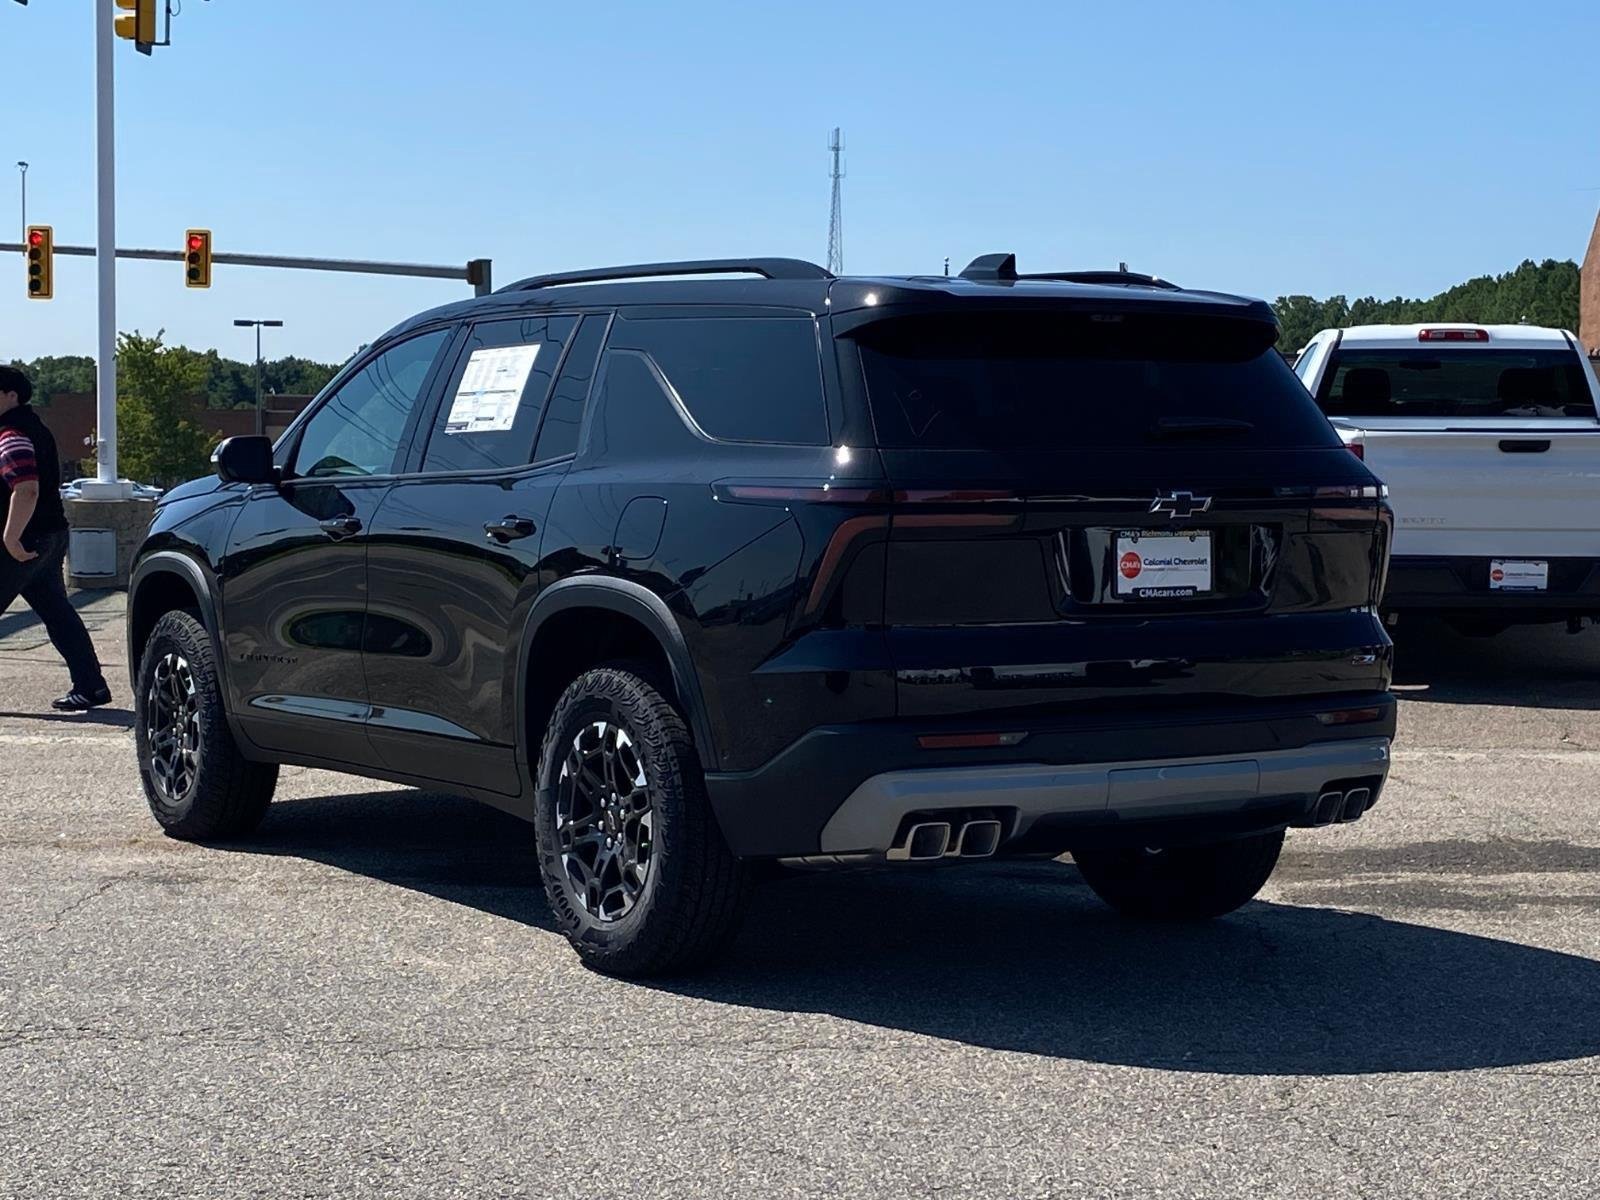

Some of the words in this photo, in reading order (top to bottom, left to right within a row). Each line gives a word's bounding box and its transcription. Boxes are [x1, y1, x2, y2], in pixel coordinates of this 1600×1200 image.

[1143, 558, 1172, 566] Colonial
[1173, 558, 1208, 566] Chevrolet
[1139, 588, 1193, 598] CMAcars.com
